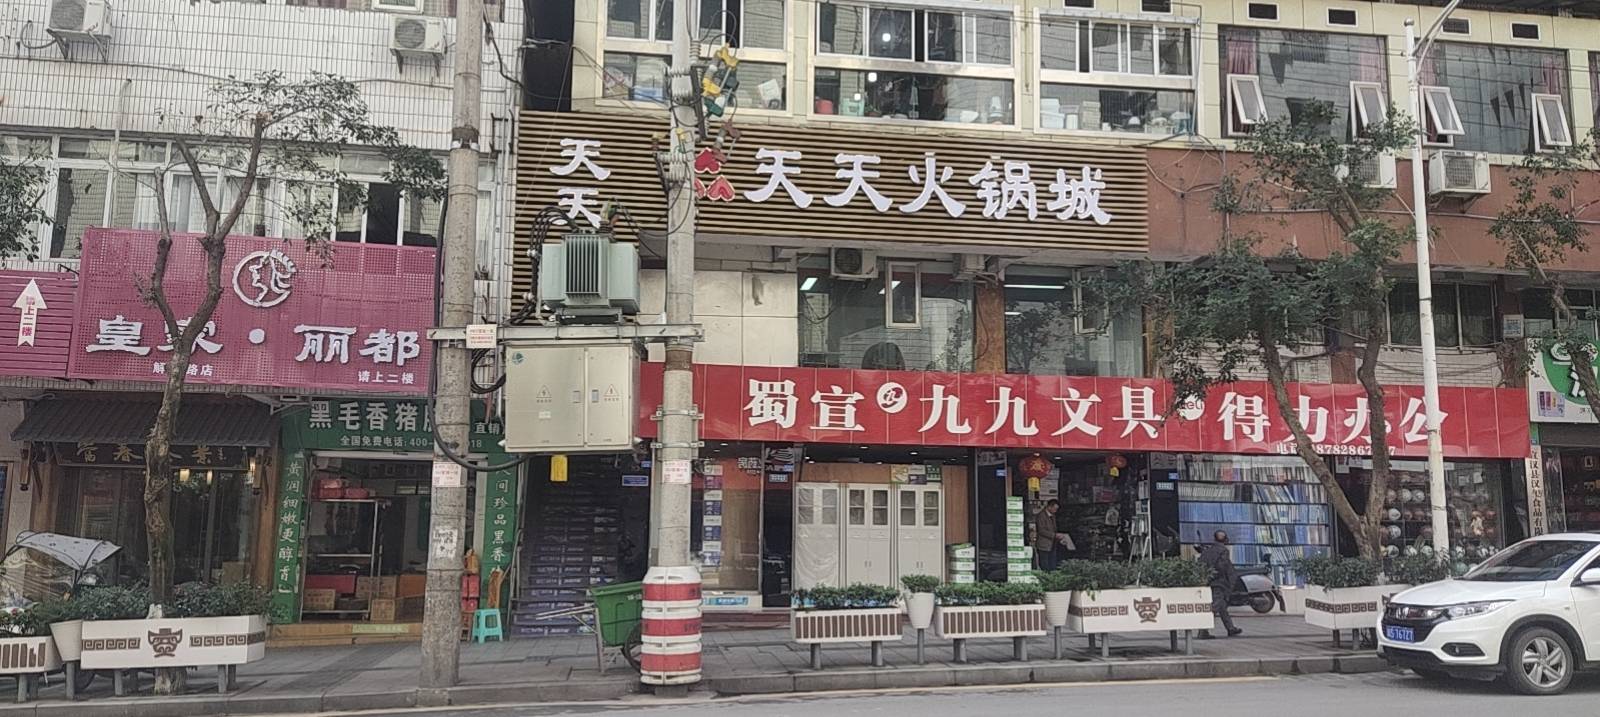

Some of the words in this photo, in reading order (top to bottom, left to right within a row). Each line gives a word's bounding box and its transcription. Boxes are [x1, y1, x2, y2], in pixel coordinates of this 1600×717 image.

[744, 148, 1112, 225] 天天火锅城
[152, 361, 213, 377] 解路店
[357, 370, 414, 385] 请上二楼
[743, 378, 865, 432] 蜀宣
[918, 383, 1164, 440] 九九文具
[1217, 391, 1448, 444] 得力办公
[490, 469, 511, 572] 间珍品黑香
